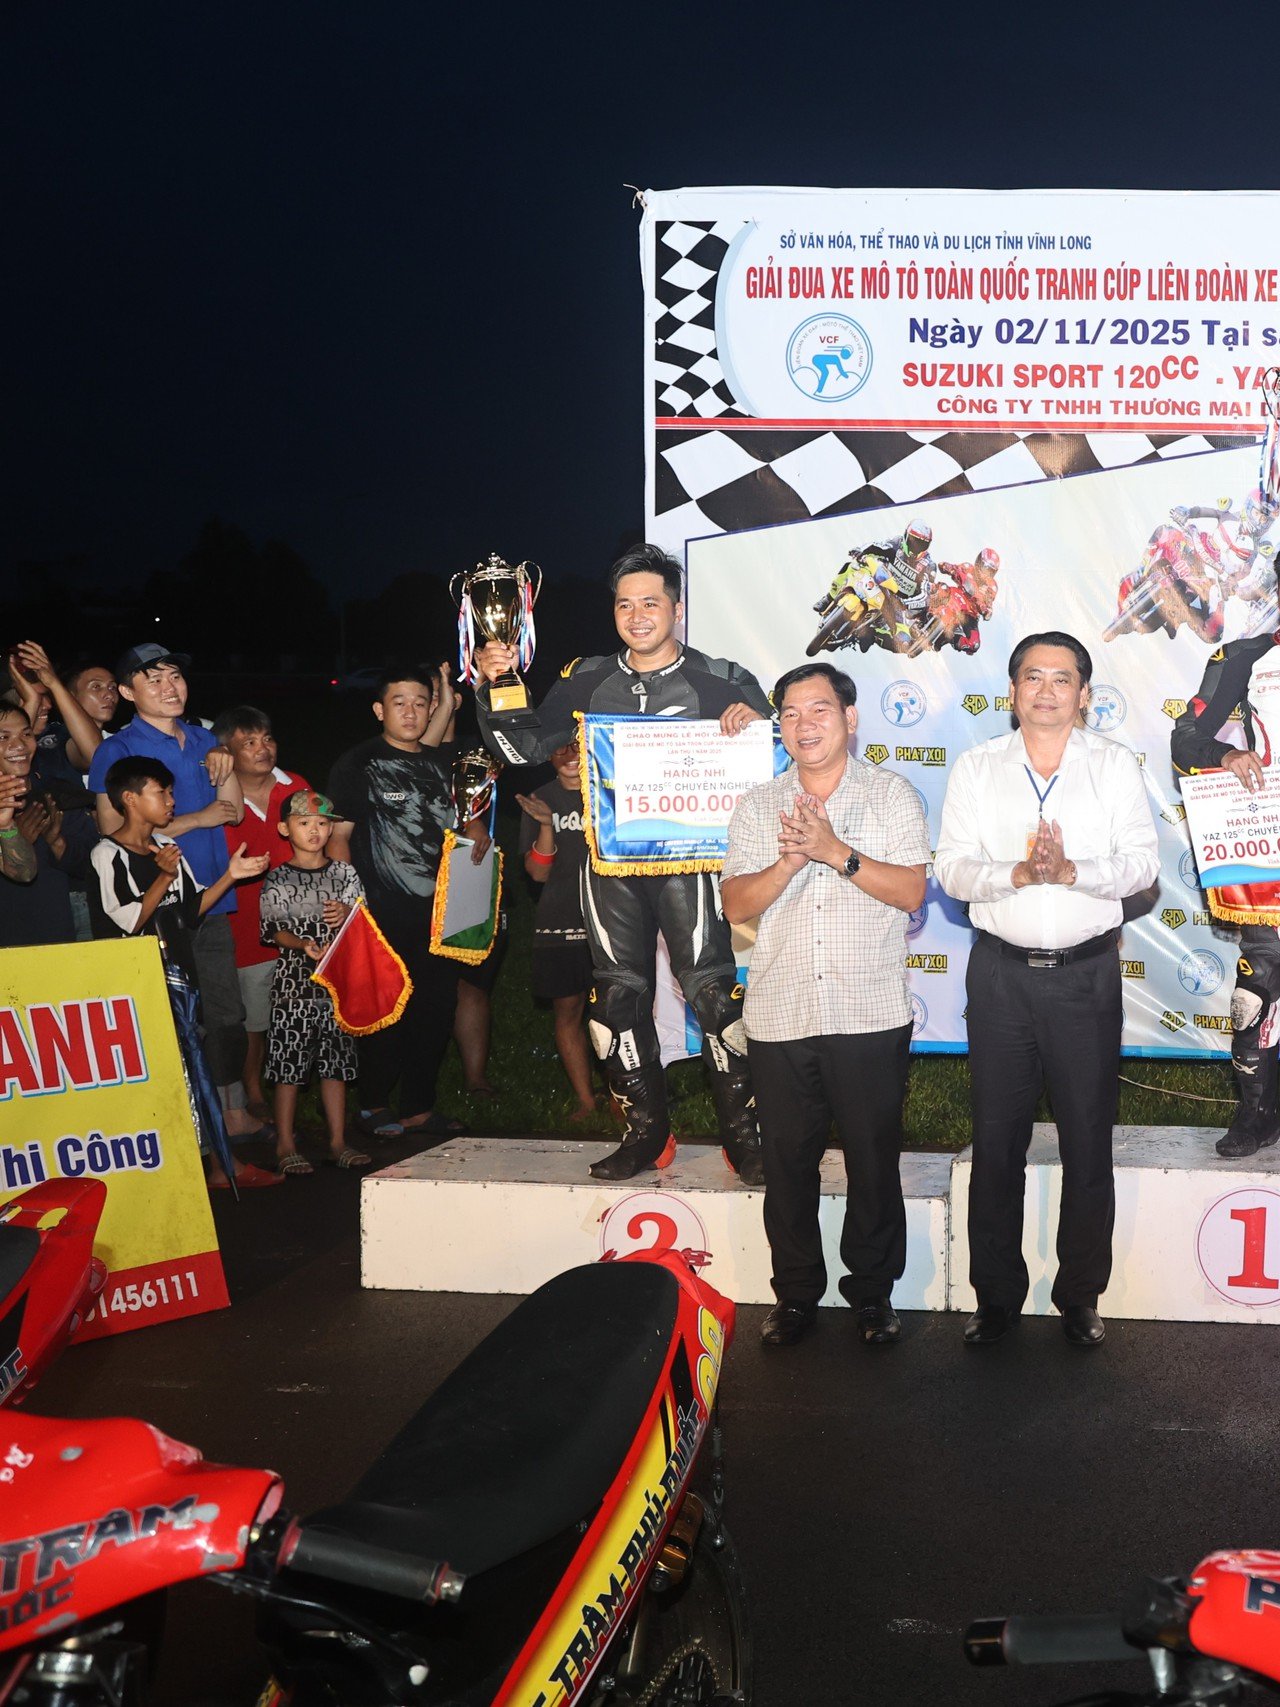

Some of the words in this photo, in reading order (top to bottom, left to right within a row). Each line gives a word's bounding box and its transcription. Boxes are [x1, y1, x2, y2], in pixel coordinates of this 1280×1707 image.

[780, 229, 796, 249] SỞ
[800, 232, 824, 249] VĂN
[829, 230, 856, 251] HÓA,
[860, 228, 885, 249] THỂ
[888, 235, 919, 250] THAO
[924, 231, 939, 249] VÀ
[944, 235, 959, 250] DU
[964, 235, 990, 253] LỊCH
[995, 231, 1022, 250] TỈNH
[1027, 231, 1055, 250] VĨNH
[1061, 235, 1092, 250] LONG
[746, 256, 782, 299] GIẢI
[788, 267, 825, 299] ĐUA
[831, 267, 854, 299] XE
[861, 260, 889, 300] MÔ
[896, 260, 919, 300] TÔ
[924, 261, 973, 300] TOÀN
[980, 256, 1029, 304] QUỐC
[1036, 268, 1097, 301] TRANH
[1104, 261, 1140, 301] CÚP
[1148, 262, 1189, 301] LIÊN
[1196, 262, 1247, 302] ĐOÀN
[1254, 269, 1277, 302] XE
[909, 318, 982, 348] Ngày
[1202, 319, 1249, 351] Tại
[902, 362, 1003, 387] SUZUKI
[1013, 364, 1103, 388] SPORT
[937, 395, 997, 413] CÔNG
[1005, 400, 1030, 414] TY
[1041, 400, 1100, 415] TNHH
[1110, 398, 1200, 416] THƯƠNG
[1209, 401, 1250, 419] MẠI
[896, 747, 925, 761] PHAT
[625, 784, 643, 792] YAZ
[1203, 832, 1220, 841] YAZ
[58, 1131, 161, 1178] Công
[627, 1212, 678, 1249] 2
[1228, 1207, 1279, 1289] 1
